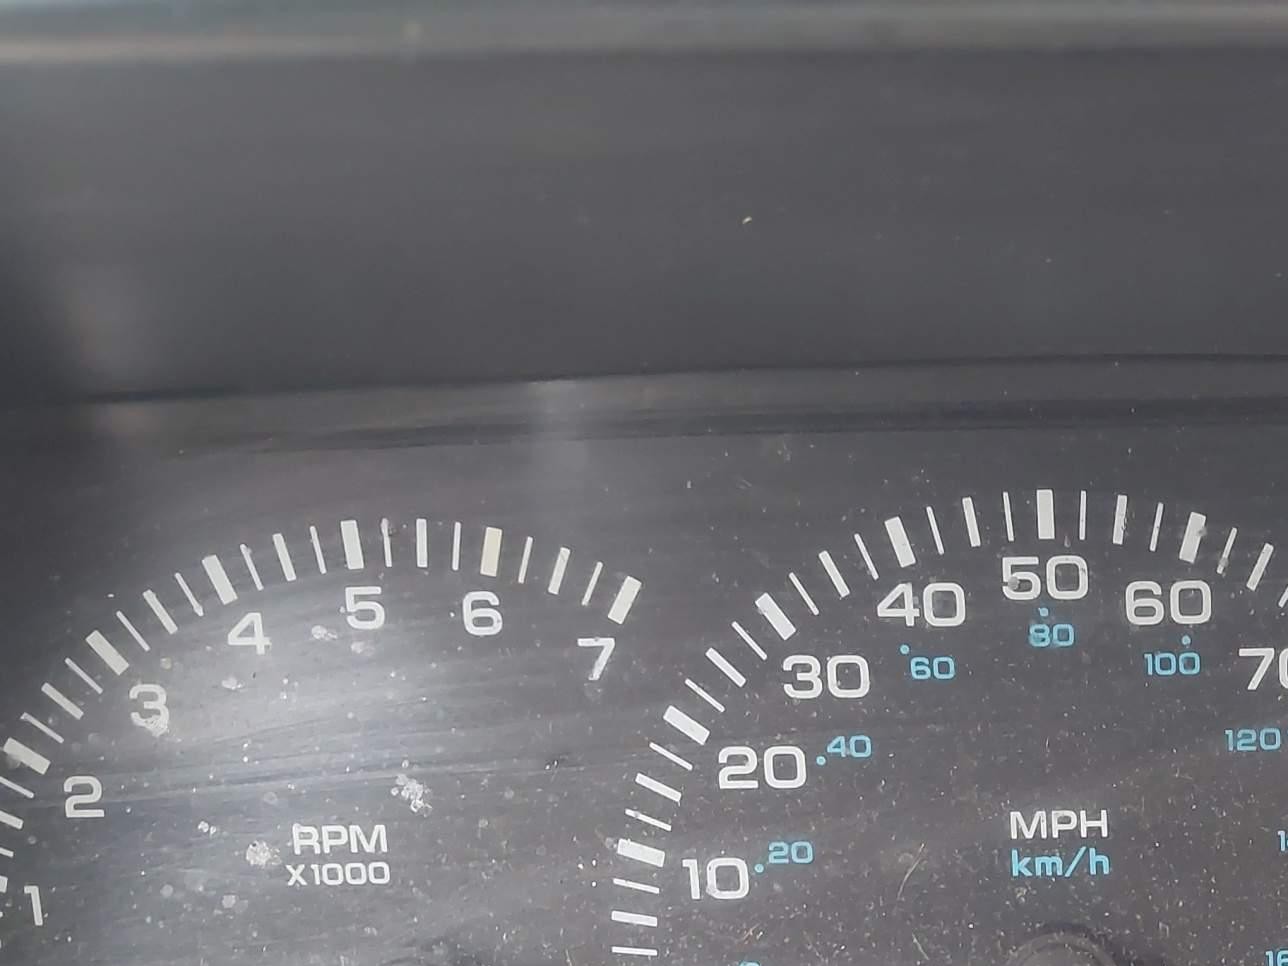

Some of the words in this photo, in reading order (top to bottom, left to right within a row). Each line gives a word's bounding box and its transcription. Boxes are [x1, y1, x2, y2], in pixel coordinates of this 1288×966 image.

[1002, 556, 1089, 600] 50
[344, 587, 385, 630] 5
[462, 591, 502, 635] 6
[877, 582, 966, 627] 40
[1125, 580, 1212, 625] 60
[227, 612, 271, 655] 4
[1028, 624, 1075, 648] 80
[577, 638, 615, 680] 7
[782, 655, 870, 699] 30
[910, 657, 955, 680] 60
[1144, 652, 1201, 676] 100
[129, 683, 169, 728] 3
[826, 735, 872, 758] 40
[1224, 728, 1282, 751] 120
[718, 746, 807, 790] 20
[64, 775, 104, 818] 2
[293, 825, 388, 855] RPM
[1009, 809, 1109, 840] MPH
[286, 861, 391, 886] X1000
[768, 841, 814, 864] 20
[1010, 847, 1111, 878] km/h
[682, 857, 749, 900] 10
[25, 886, 43, 925] 1
